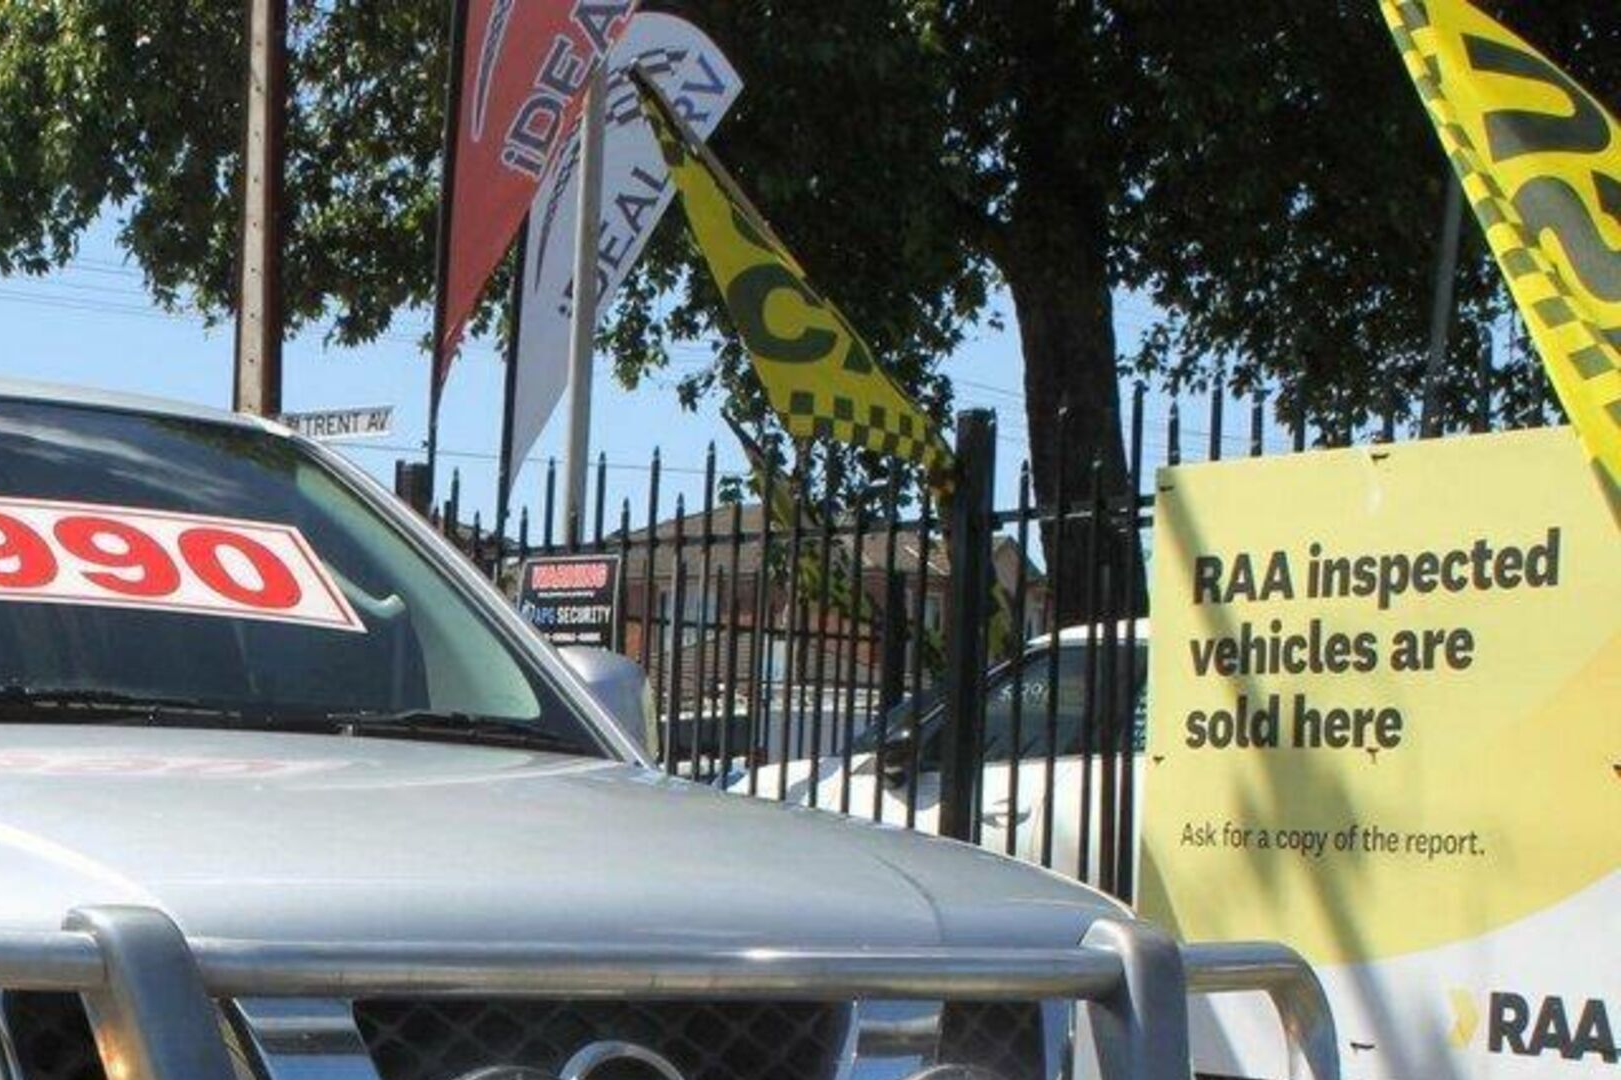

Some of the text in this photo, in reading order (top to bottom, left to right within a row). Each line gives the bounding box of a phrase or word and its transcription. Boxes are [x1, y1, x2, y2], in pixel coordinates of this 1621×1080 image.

[303, 411, 361, 436] TRENT
[1193, 527, 1561, 610] RAA inspected
[557, 605, 611, 625] SECURITY
[1190, 619, 1475, 676] vehicles are
[1185, 693, 1403, 749] sold here
[1180, 822, 1485, 860] Ask for a copy of the report.
[1488, 991, 1618, 1064] RAA
